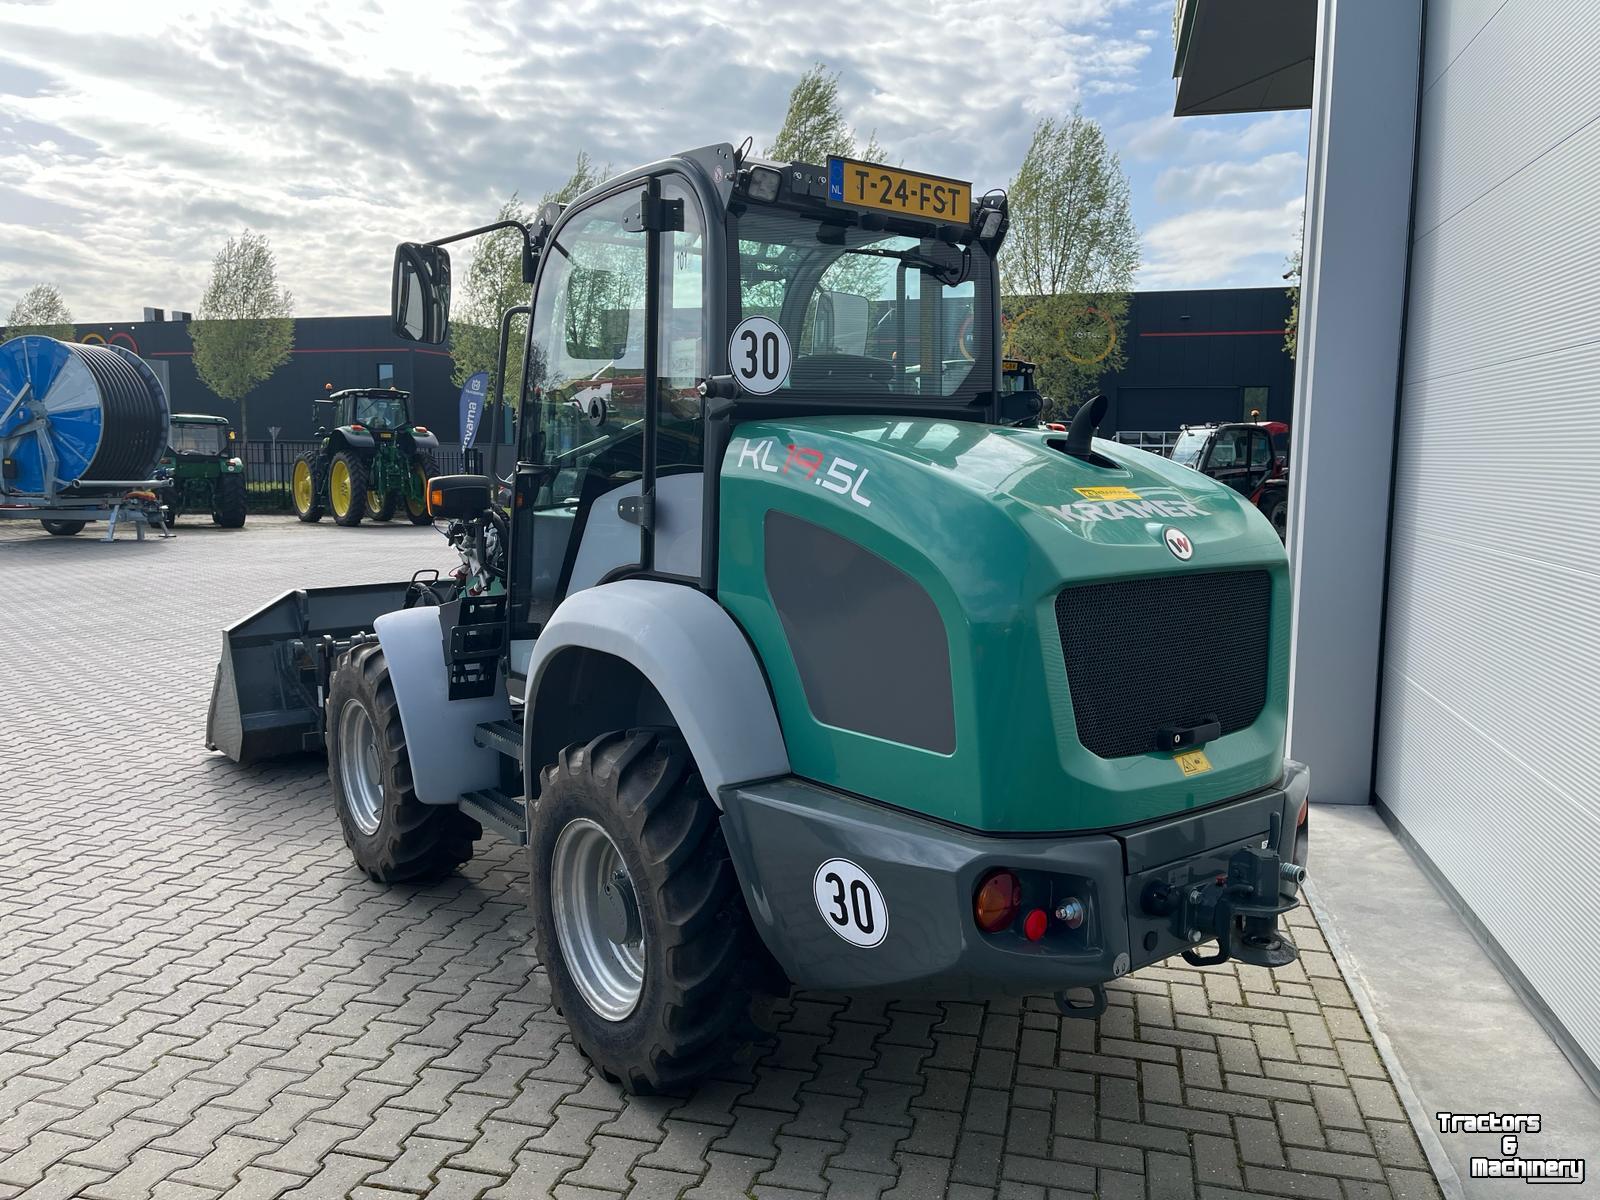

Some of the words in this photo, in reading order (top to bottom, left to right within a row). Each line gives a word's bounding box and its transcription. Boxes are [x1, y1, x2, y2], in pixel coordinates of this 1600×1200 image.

[831, 184, 842, 196] NL
[855, 169, 961, 217] T-24-FST
[740, 329, 780, 381] 30
[737, 439, 872, 508] KL19.5L
[1043, 500, 1213, 523] KRAMER
[825, 872, 875, 935] 30
